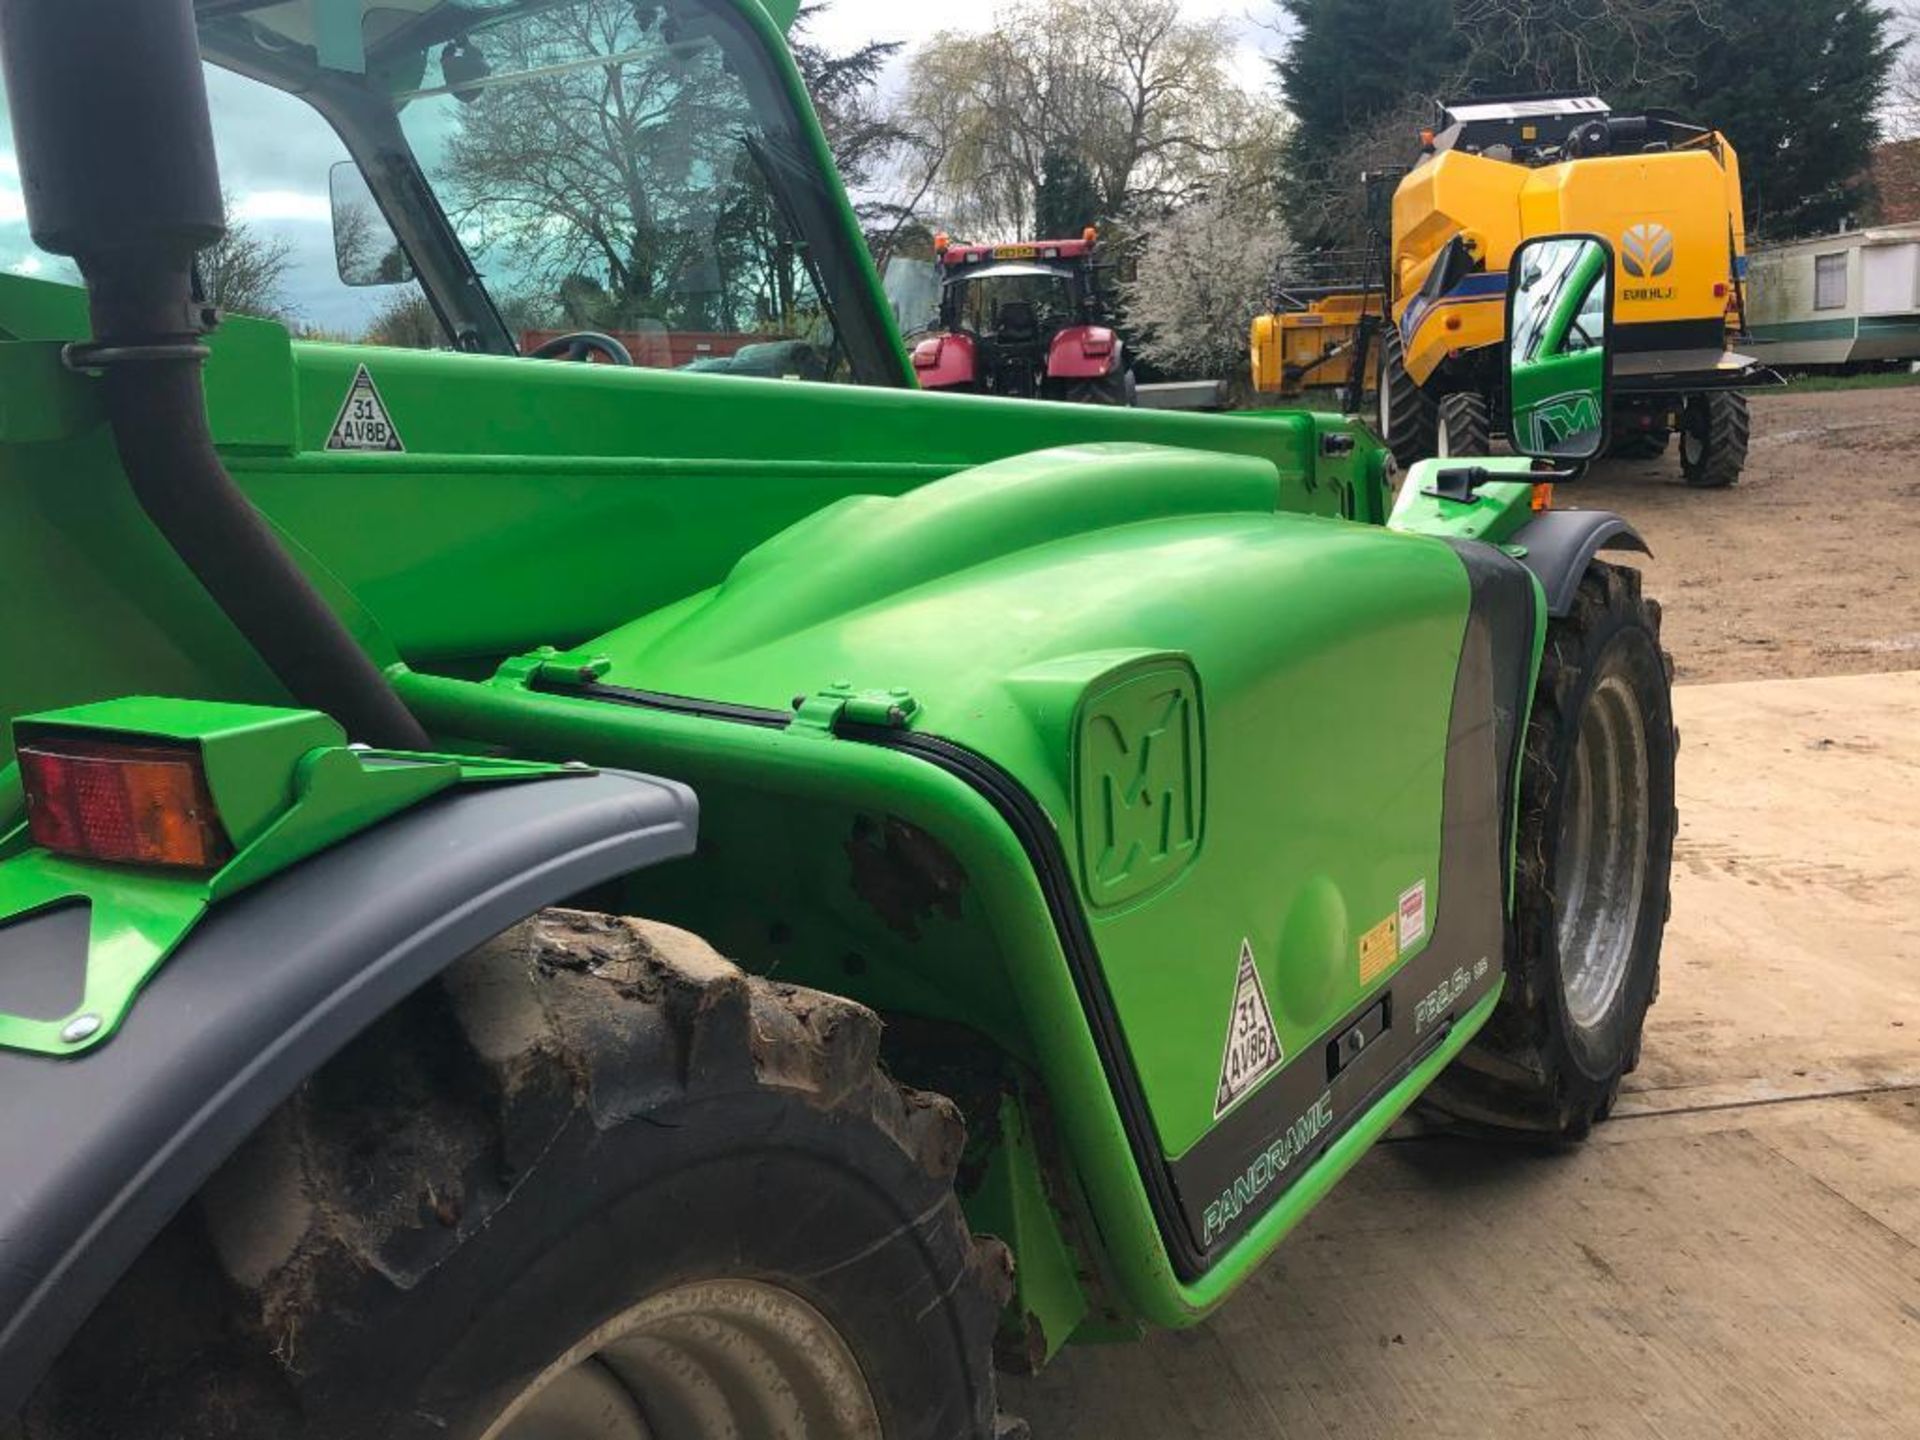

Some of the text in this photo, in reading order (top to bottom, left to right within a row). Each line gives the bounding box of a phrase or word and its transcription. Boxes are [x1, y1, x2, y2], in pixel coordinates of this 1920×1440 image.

[353, 399, 375, 420] 31
[344, 421, 387, 443] AV8B
[1238, 995, 1257, 1037] 31
[1231, 1027, 1268, 1080] AV8B
[1203, 1089, 1334, 1247] PANORAMIC
